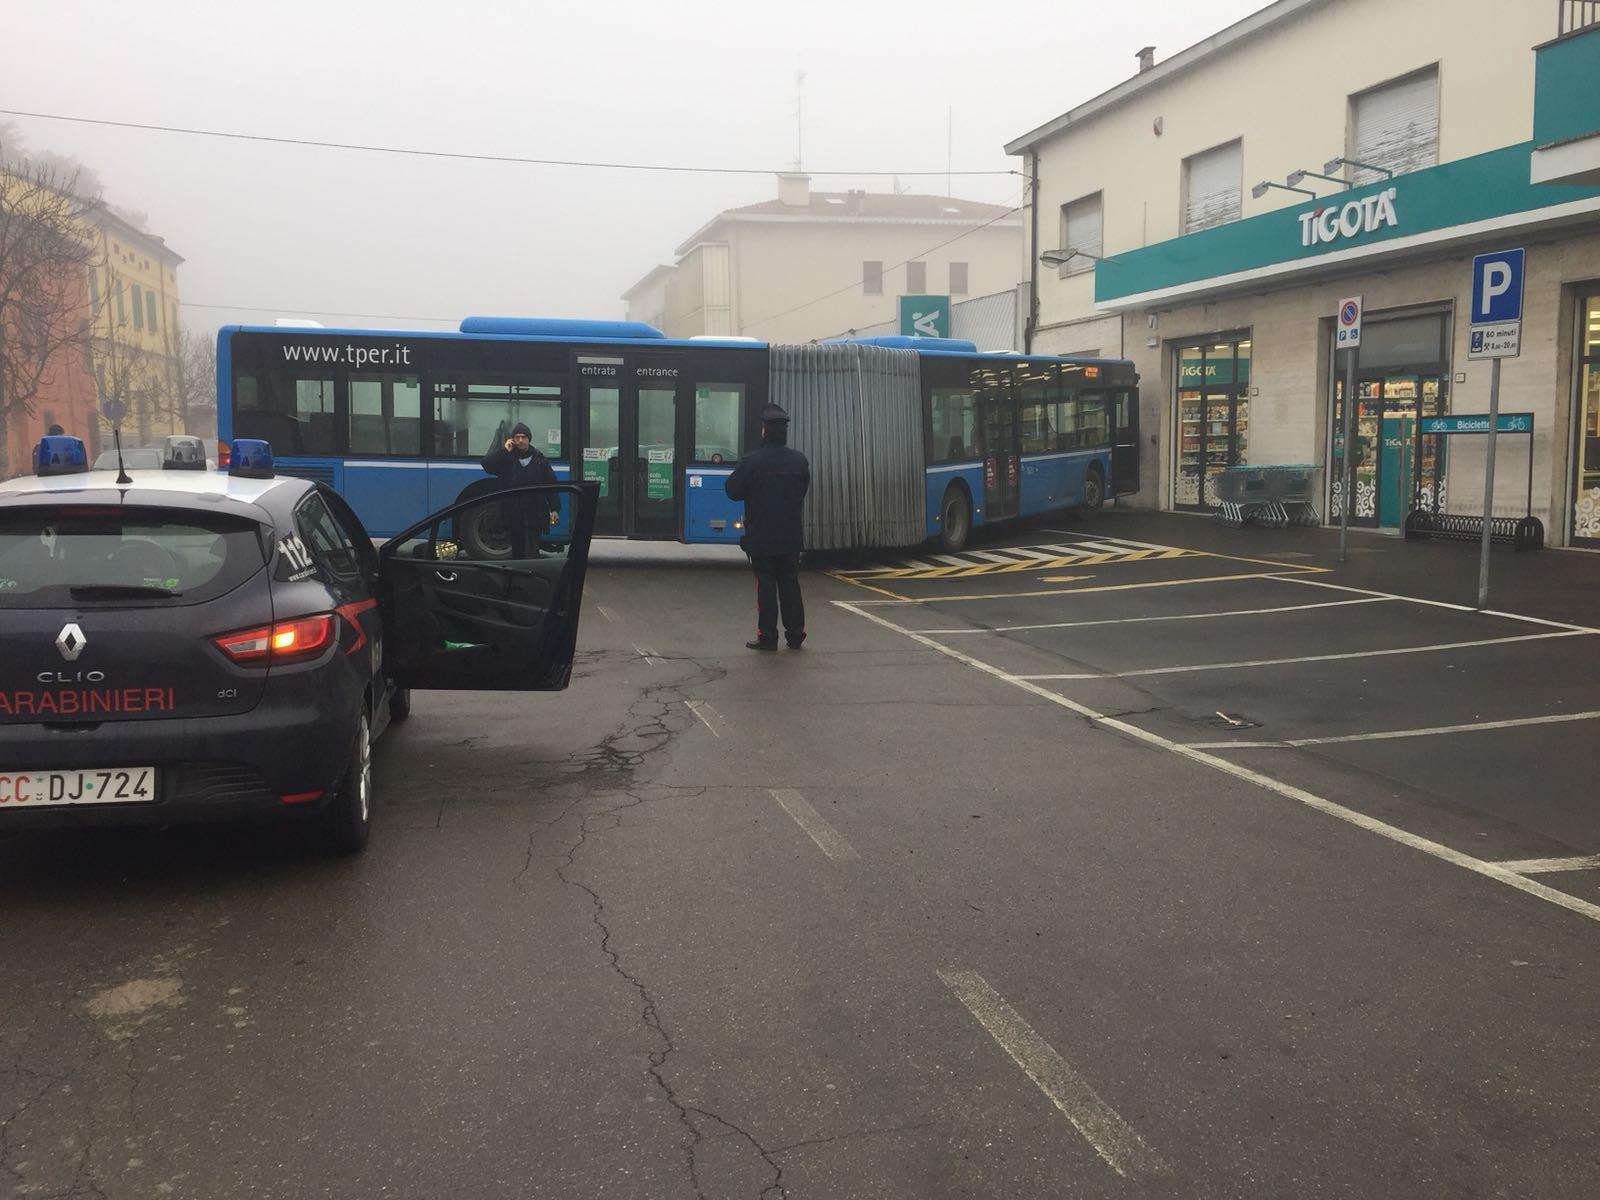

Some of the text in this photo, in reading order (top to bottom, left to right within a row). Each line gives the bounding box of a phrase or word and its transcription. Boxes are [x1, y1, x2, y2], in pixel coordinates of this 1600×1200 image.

[1481, 261, 1512, 315] P
[1496, 329, 1517, 337] minuti
[283, 344, 411, 368] www.tper.it
[581, 366, 617, 376] entrata
[636, 366, 679, 377] entrance
[277, 536, 314, 571] 112
[37, 671, 105, 683] CLIO
[49, 773, 84, 801] DJ
[96, 770, 149, 800] 724
